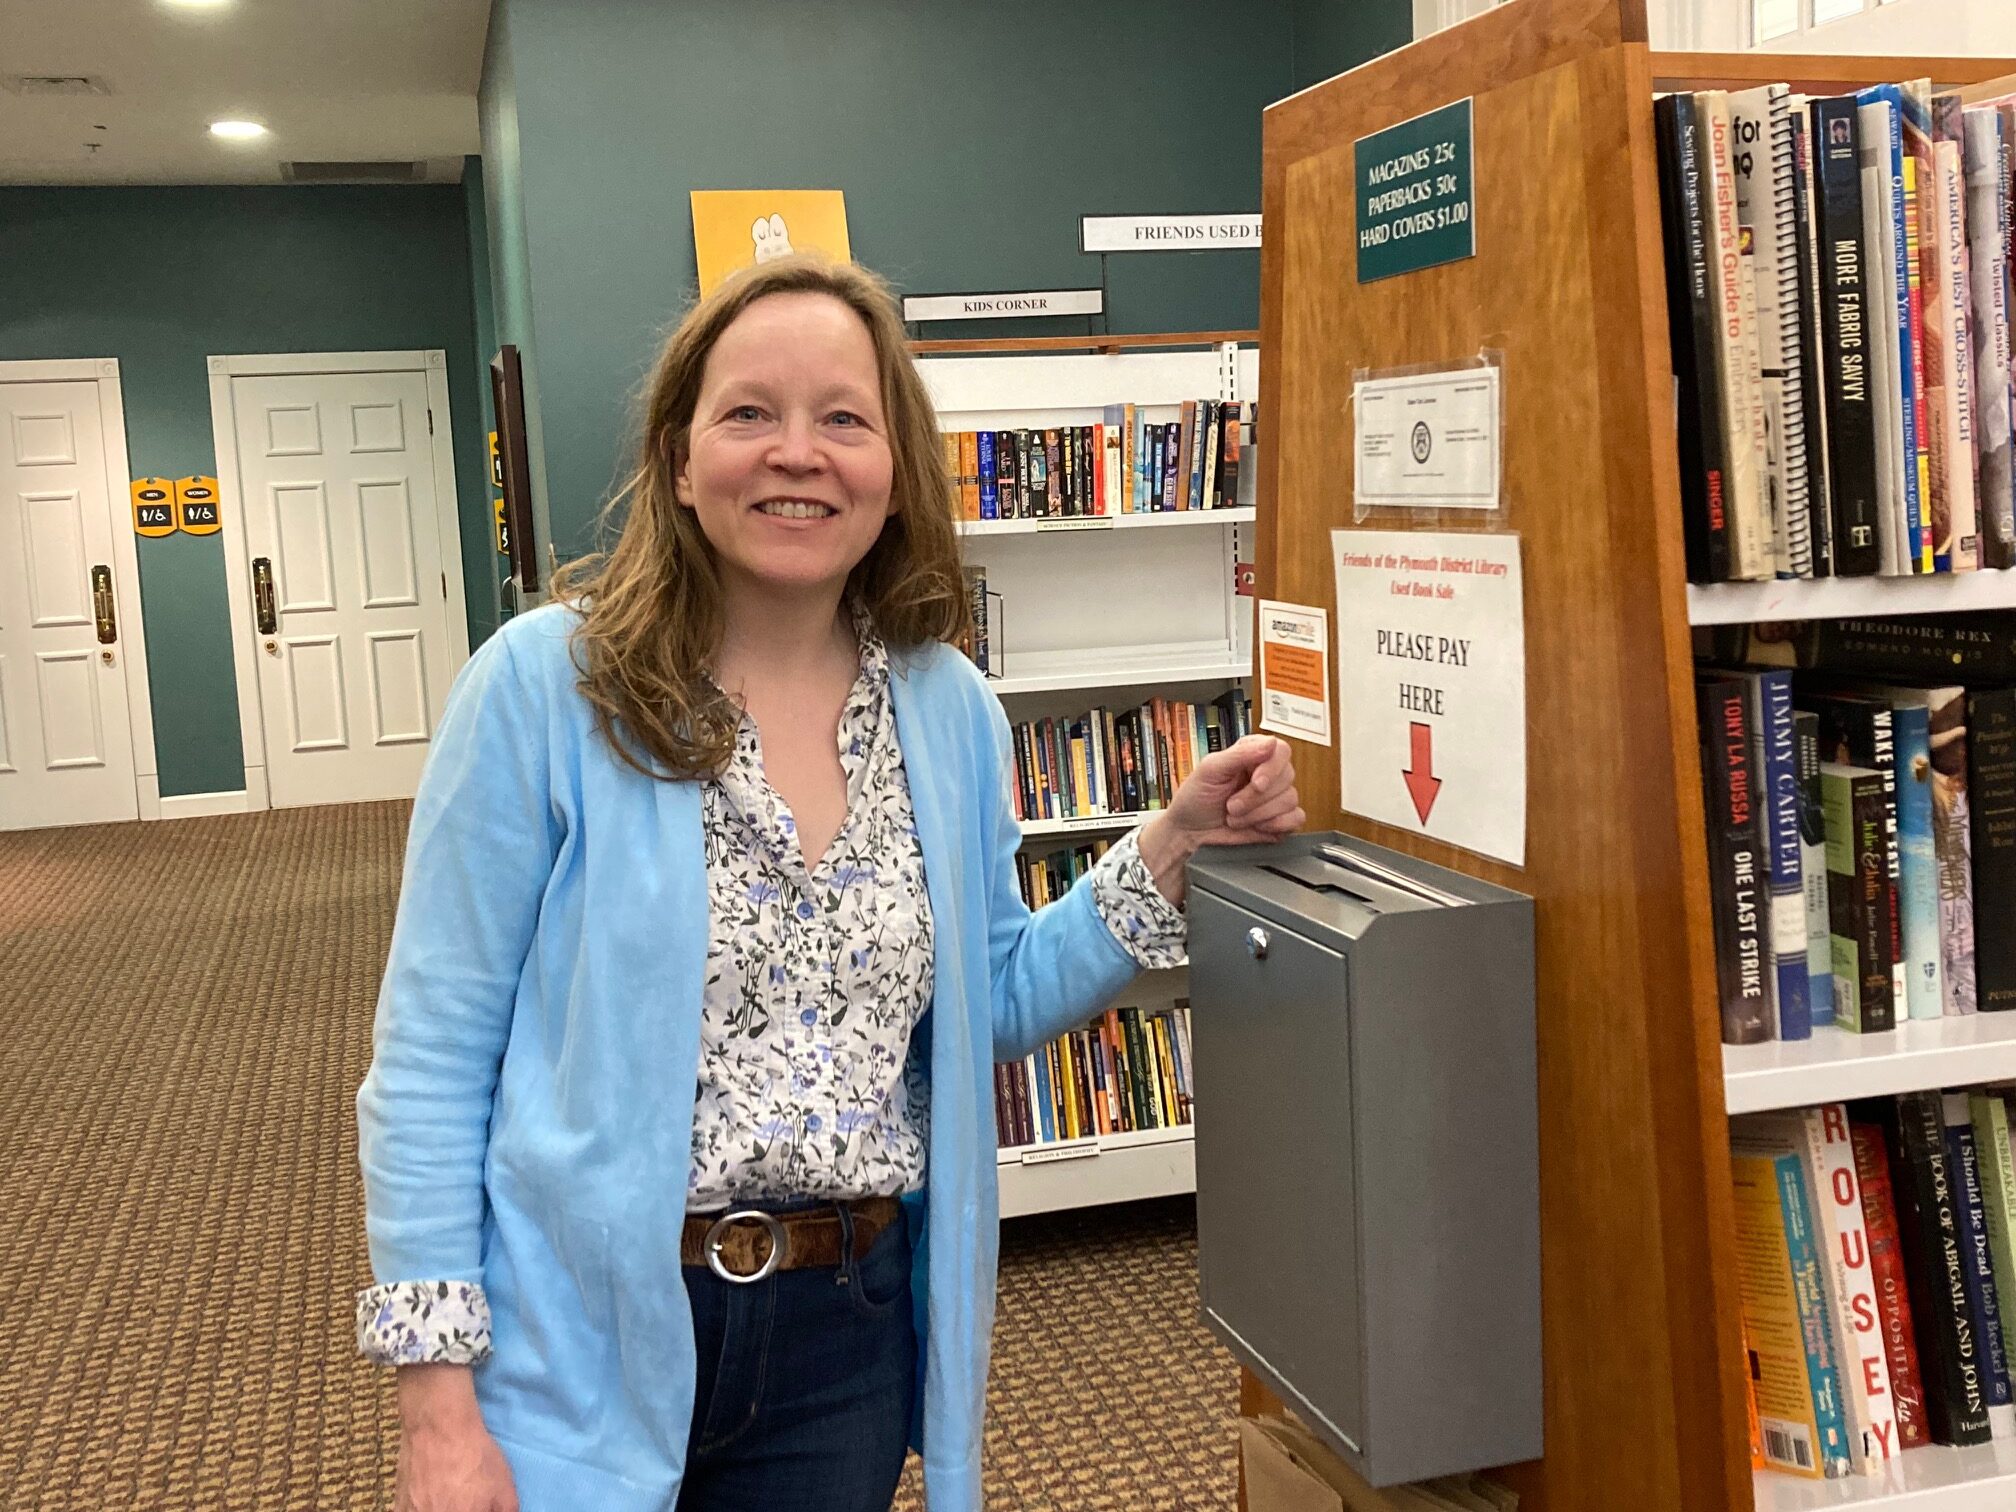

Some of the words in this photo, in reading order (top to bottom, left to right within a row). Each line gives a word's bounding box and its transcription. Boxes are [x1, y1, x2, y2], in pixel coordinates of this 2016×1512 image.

[1682, 125, 1695, 170] Sewing
[1711, 116, 1727, 168] Joan
[1889, 108, 1899, 149] SEWARD
[1368, 147, 1430, 186] MAGAZINES
[1434, 142, 1456, 165] 25¢
[2001, 143, 2014, 198] Creative
[1368, 179, 1432, 217] PAPERBACKS
[1436, 174, 1457, 197] 50¢
[1684, 171, 1700, 219] Projects
[1716, 171, 1734, 248] Fisher's
[1891, 175, 1904, 220] QUILTS
[1947, 169, 1962, 266] AMERICA'S
[1134, 225, 1205, 240] FRIENDS
[1209, 224, 1250, 239] USED
[1360, 222, 1390, 248] HARD
[1392, 213, 1436, 240] COVERS
[1437, 201, 1469, 228] $1.00
[1691, 220, 1703, 236] for
[1893, 222, 1906, 268] AROUND
[2003, 199, 2014, 256] Kindness
[1693, 238, 1705, 257] the
[1834, 239, 1859, 286] MORE
[1693, 260, 1706, 299] Home
[1722, 251, 1740, 314] Guide
[1896, 271, 1907, 294] THE
[1952, 269, 1965, 310] BEST
[1991, 257, 2003, 308] Twisted
[963, 301, 993, 313] KIDS
[996, 299, 1048, 311] CORNER
[1727, 318, 1741, 338] to
[1837, 292, 1862, 348] FABRIC
[1896, 297, 1911, 329] YEAR
[1994, 312, 2005, 368] Classics
[1728, 345, 1747, 434] Embroidery
[1749, 350, 1760, 384] and
[1840, 355, 1865, 401] SAVVY
[1954, 316, 1970, 442] CROSS-STITCH
[1752, 394, 1765, 453] shade
[1903, 397, 1917, 493] STERLING/MUSEUM
[1706, 470, 1725, 531] SINGER
[1907, 494, 1920, 528] QUILTS
[1342, 552, 1373, 568] Friends
[1374, 553, 1383, 568] of
[1384, 554, 1398, 569] the
[1399, 555, 1438, 573] Plymouth
[1440, 557, 1473, 574] District
[1474, 559, 1508, 579] Library
[1390, 580, 1411, 597] Used
[1412, 581, 1434, 598] Book
[1435, 582, 1455, 600] Sale
[1376, 629, 1434, 663] PLEASE
[1437, 636, 1472, 667] PAY
[1838, 621, 1944, 640] THEODORE
[1954, 630, 1993, 643] REX
[1399, 683, 1445, 716] HERE
[1723, 696, 1744, 738] TONY
[1770, 682, 1794, 762] JIMMY
[1727, 743, 1745, 766] LA
[1873, 710, 1894, 763] WAKE
[1729, 770, 1750, 826] RUSSA
[1776, 773, 1800, 875] CARTER
[1862, 819, 1878, 848] Julie
[1734, 851, 1755, 886] ONE
[1860, 850, 1881, 868] &
[1865, 868, 1881, 901] Julia
[1736, 890, 1758, 933] LAST
[1739, 938, 1762, 999] STRIKE
[1148, 1096, 1157, 1115] GOD
[1922, 1111, 1940, 1149] THE
[1853, 1135, 1875, 1180] AMY
[1930, 1154, 1950, 1203] BOOK
[1961, 1145, 1982, 1204] Should
[1997, 1126, 2016, 1217] UNBREAKABLE
[1940, 1206, 1954, 1231] OF
[1970, 1209, 1983, 1230] Be
[1943, 1236, 1966, 1314] ABIGAIL
[1973, 1233, 1993, 1277] Dead
[1822, 1104, 1892, 1461] ROUSEY
[1981, 1283, 1998, 1316] Bob
[1884, 1277, 1909, 1377] OPPOSITE
[1954, 1315, 1975, 1358] AND
[1986, 1320, 2006, 1374] Beckel
[1960, 1363, 1982, 1414] JOHN
